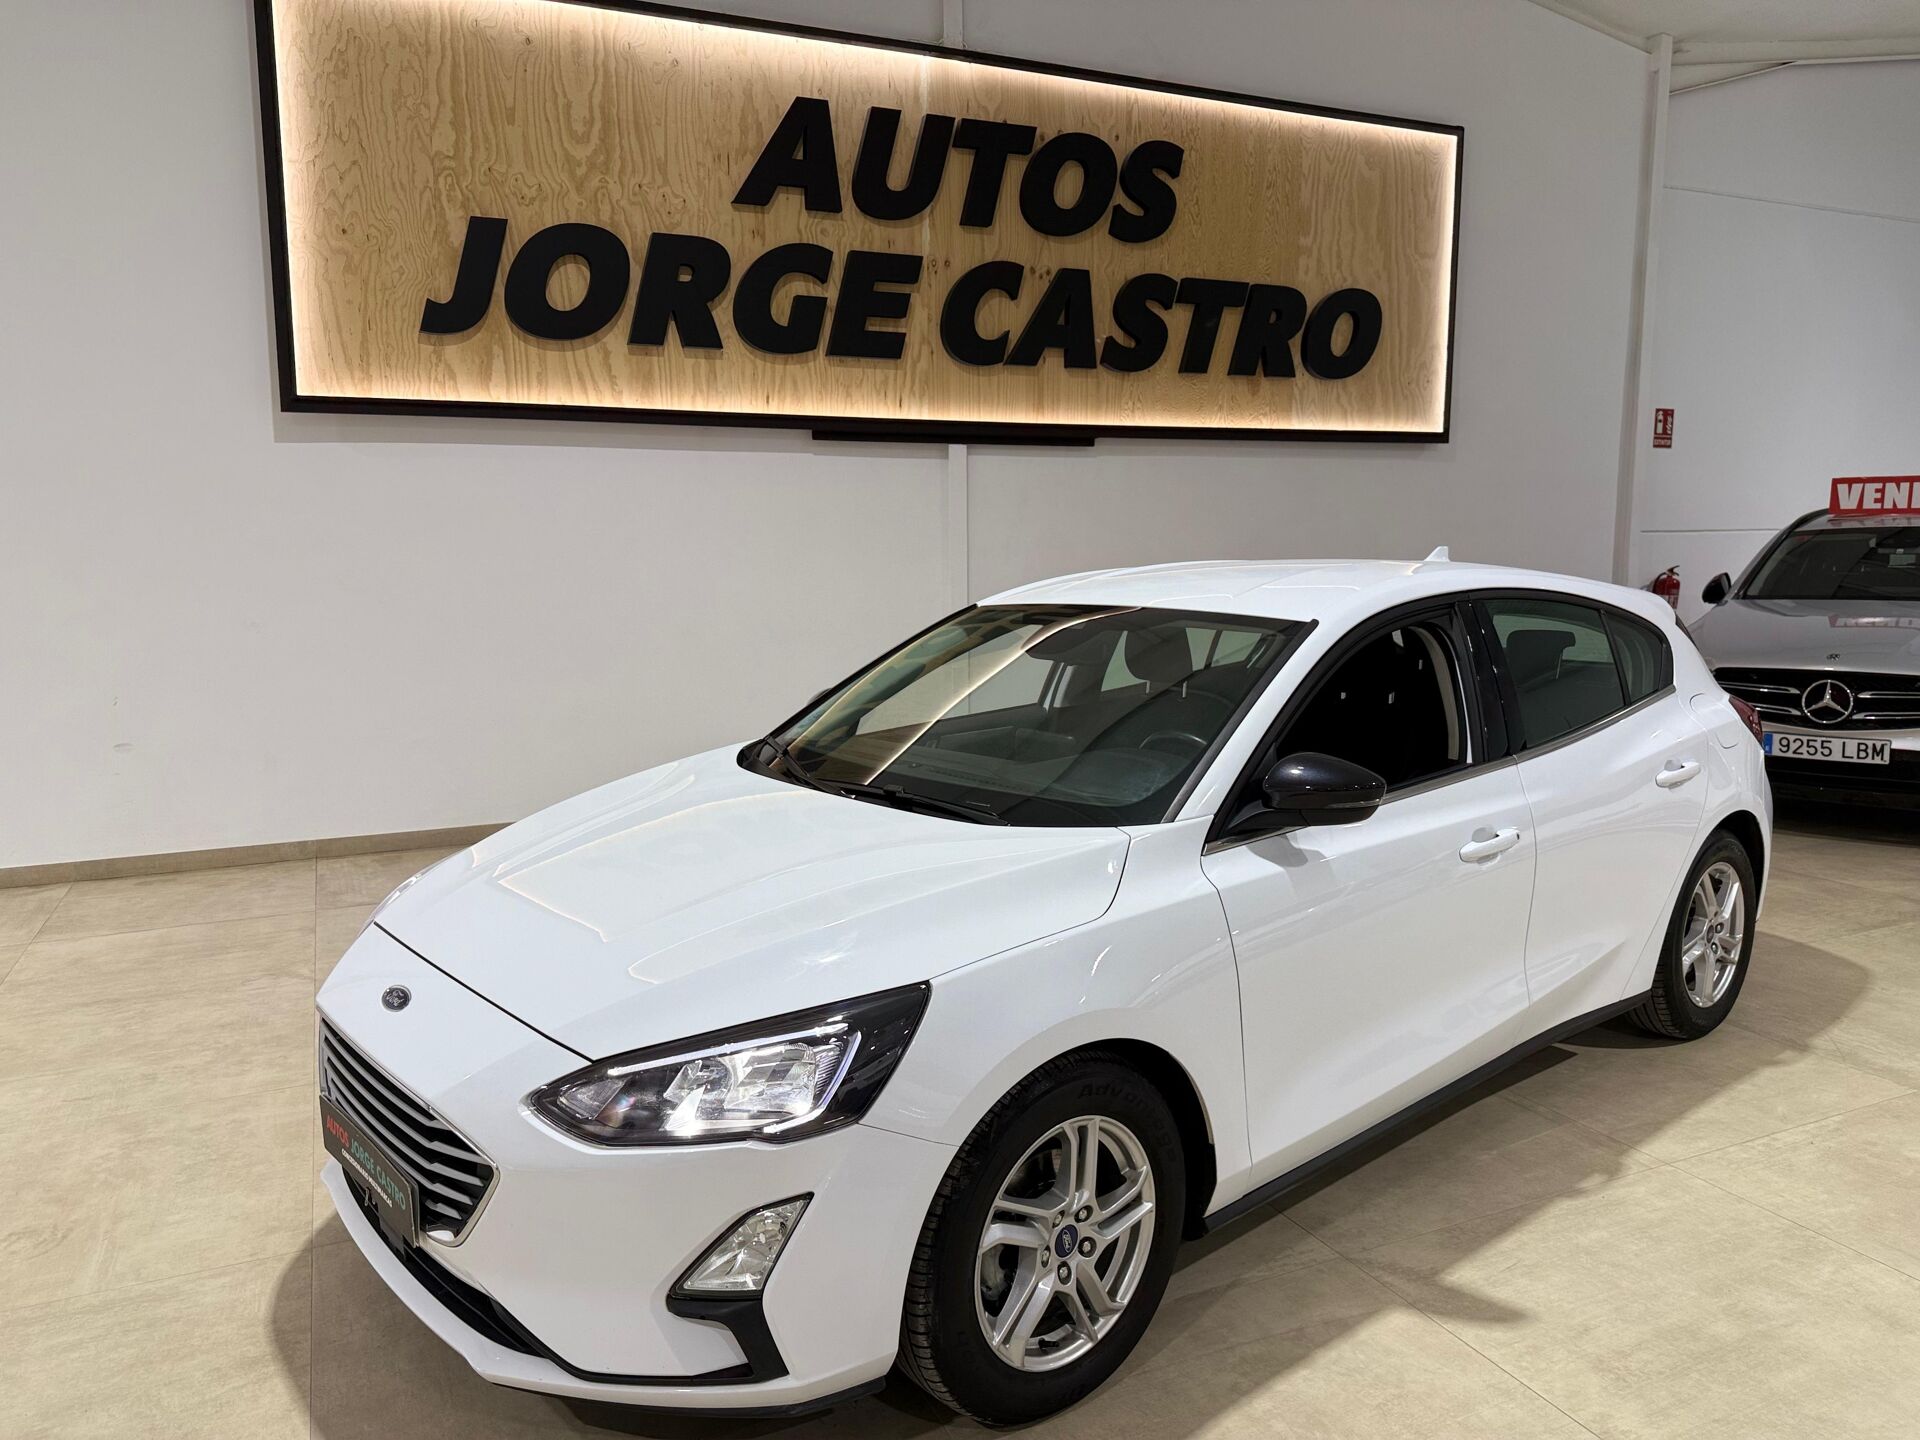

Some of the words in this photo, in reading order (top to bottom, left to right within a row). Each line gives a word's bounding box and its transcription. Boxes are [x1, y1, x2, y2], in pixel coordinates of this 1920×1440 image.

[731, 96, 1184, 243] AUTOS
[419, 216, 923, 359] JORGE
[940, 260, 1382, 380] CASTRO
[1778, 736, 1833, 758] 9255
[1841, 740, 1886, 761] LBM
[326, 1114, 350, 1148] AUTOS
[350, 1138, 375, 1174] JORGE
[376, 1166, 406, 1210] CASTRO
